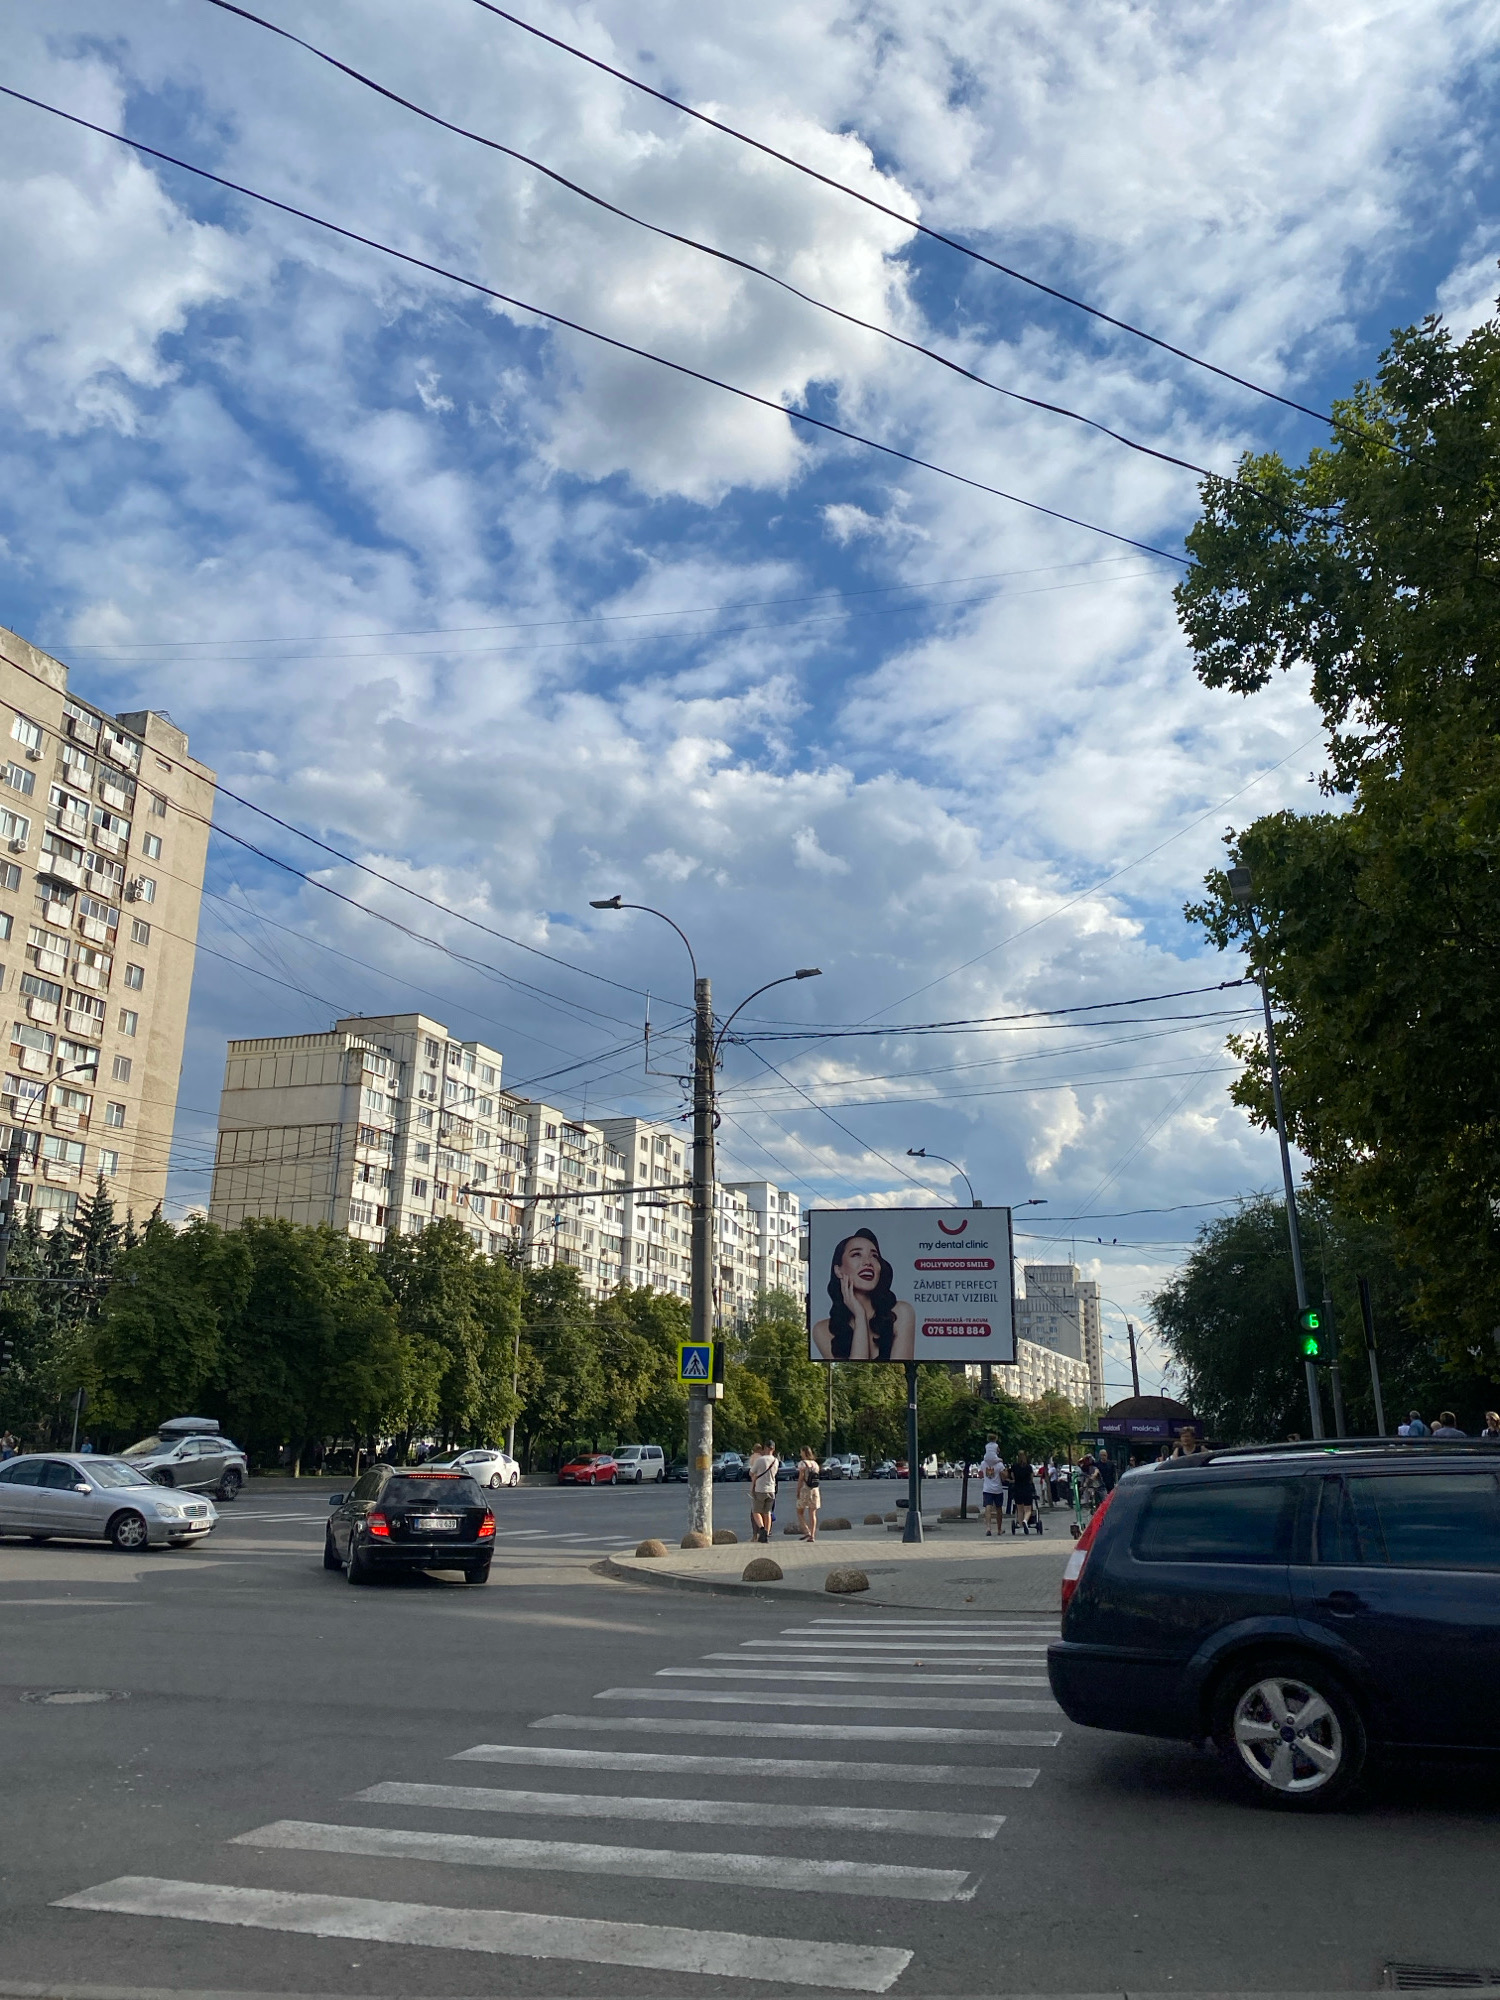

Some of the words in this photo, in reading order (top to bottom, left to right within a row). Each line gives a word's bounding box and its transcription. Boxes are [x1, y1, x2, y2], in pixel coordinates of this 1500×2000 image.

[918, 1241, 933, 1251] my
[935, 1240, 964, 1249] dental
[965, 1240, 989, 1249] clinic
[913, 1279, 952, 1290] ZÂMBET
[955, 1280, 998, 1290] PERFECT
[914, 1293, 959, 1302] REZULTAT
[962, 1293, 999, 1302] VIZIBIL
[1308, 1313, 1319, 1328] 6
[927, 1326, 944, 1335] 076
[946, 1326, 964, 1335] 588
[966, 1326, 985, 1335] 884
